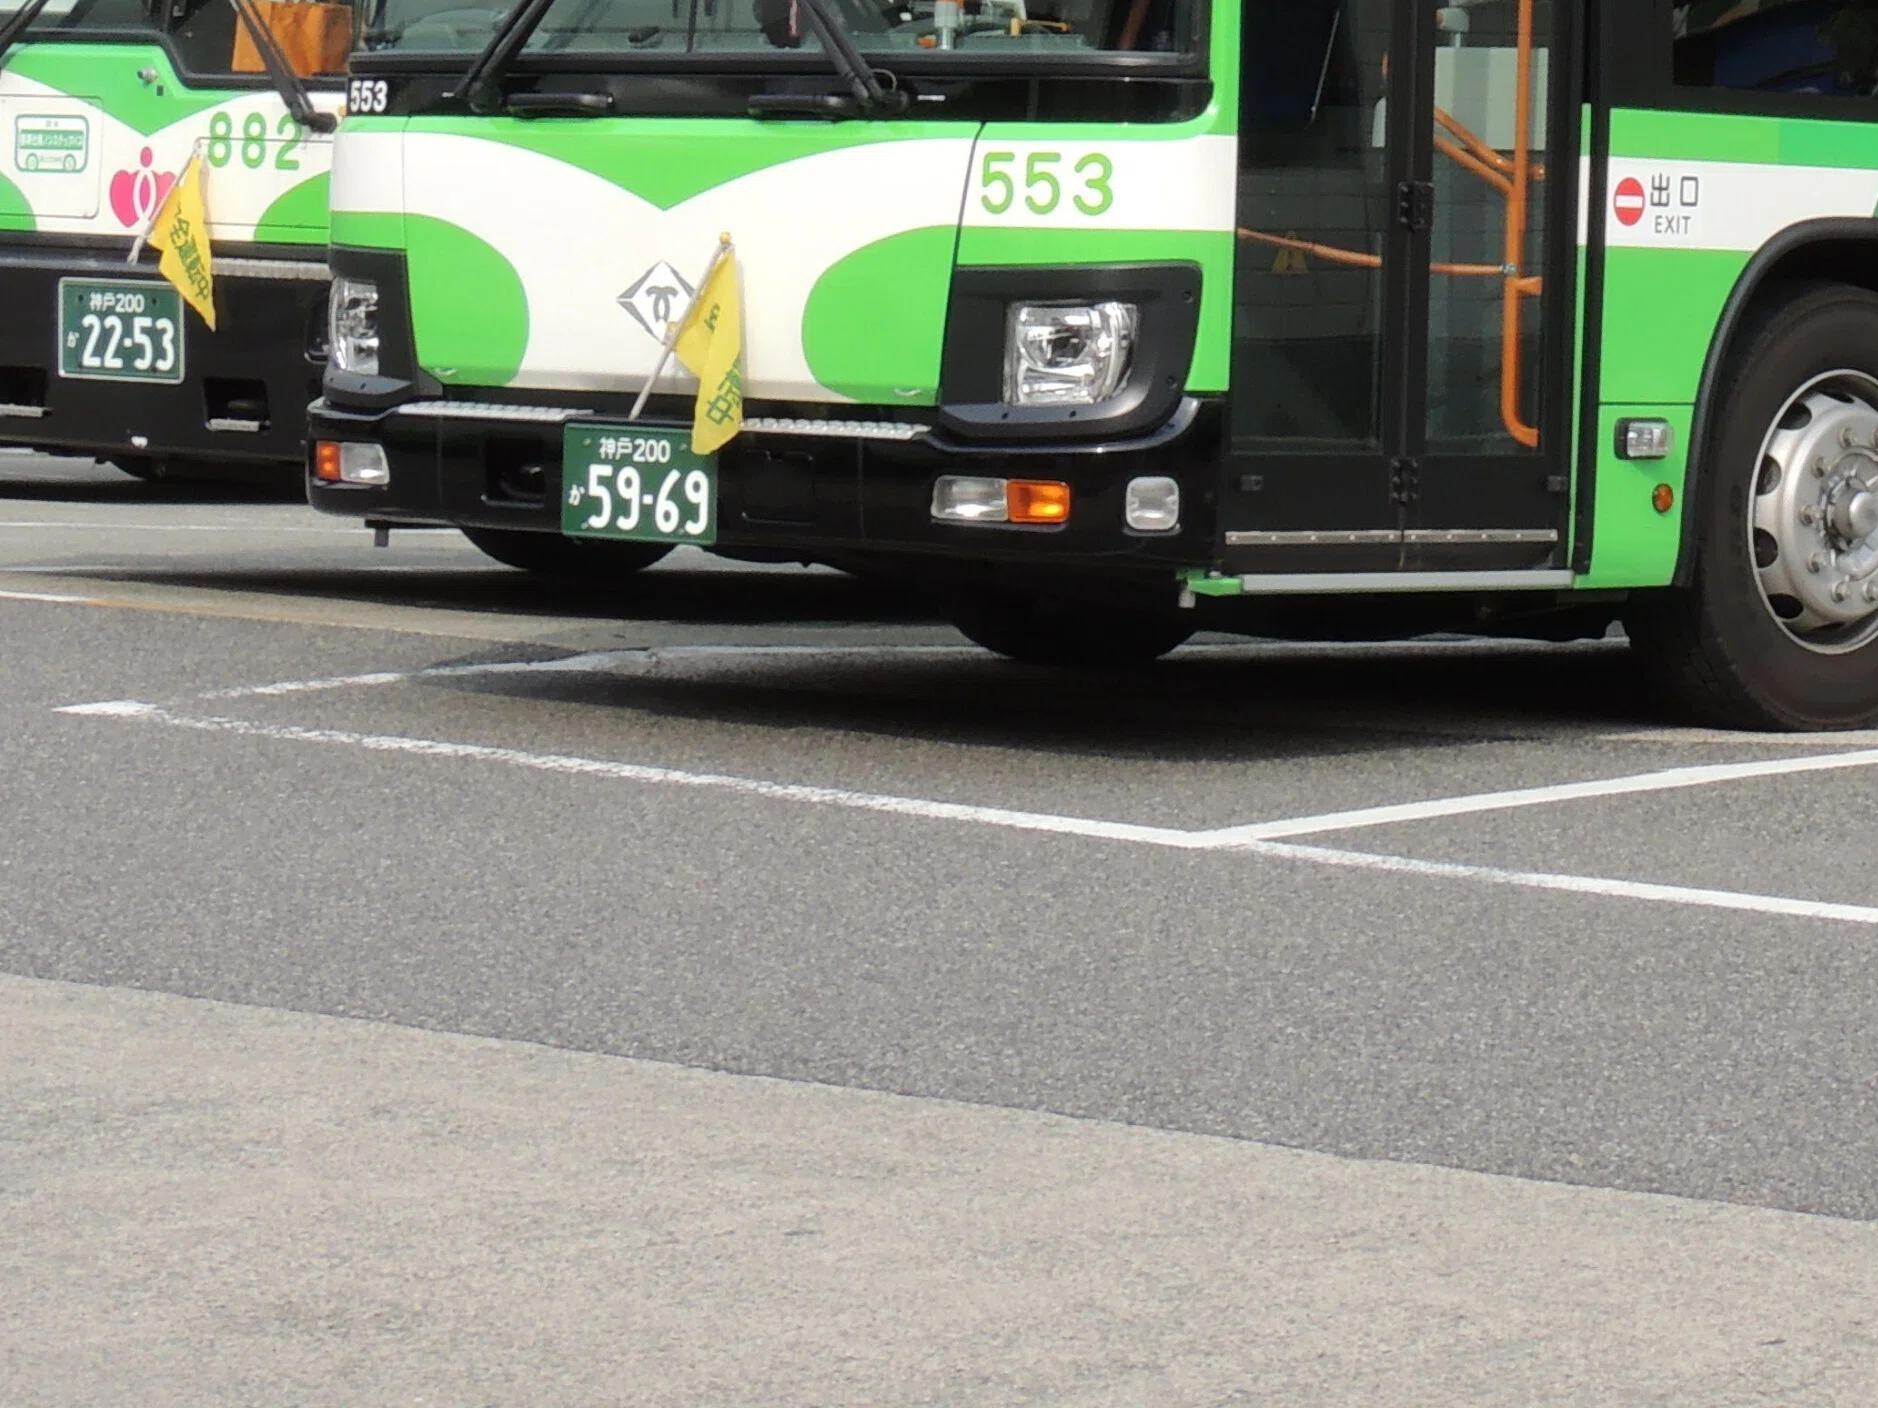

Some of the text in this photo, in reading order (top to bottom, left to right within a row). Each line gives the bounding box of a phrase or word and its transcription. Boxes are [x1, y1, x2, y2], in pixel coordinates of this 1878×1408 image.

[349, 80, 388, 113] 553
[207, 111, 305, 171] 882
[980, 151, 1115, 216] 553
[1650, 172, 1700, 210] 出口
[1654, 214, 1691, 236] EXIT
[89, 292, 146, 314] 神戸200
[599, 437, 672, 464] 神戸200
[587, 463, 710, 537] 59-69
